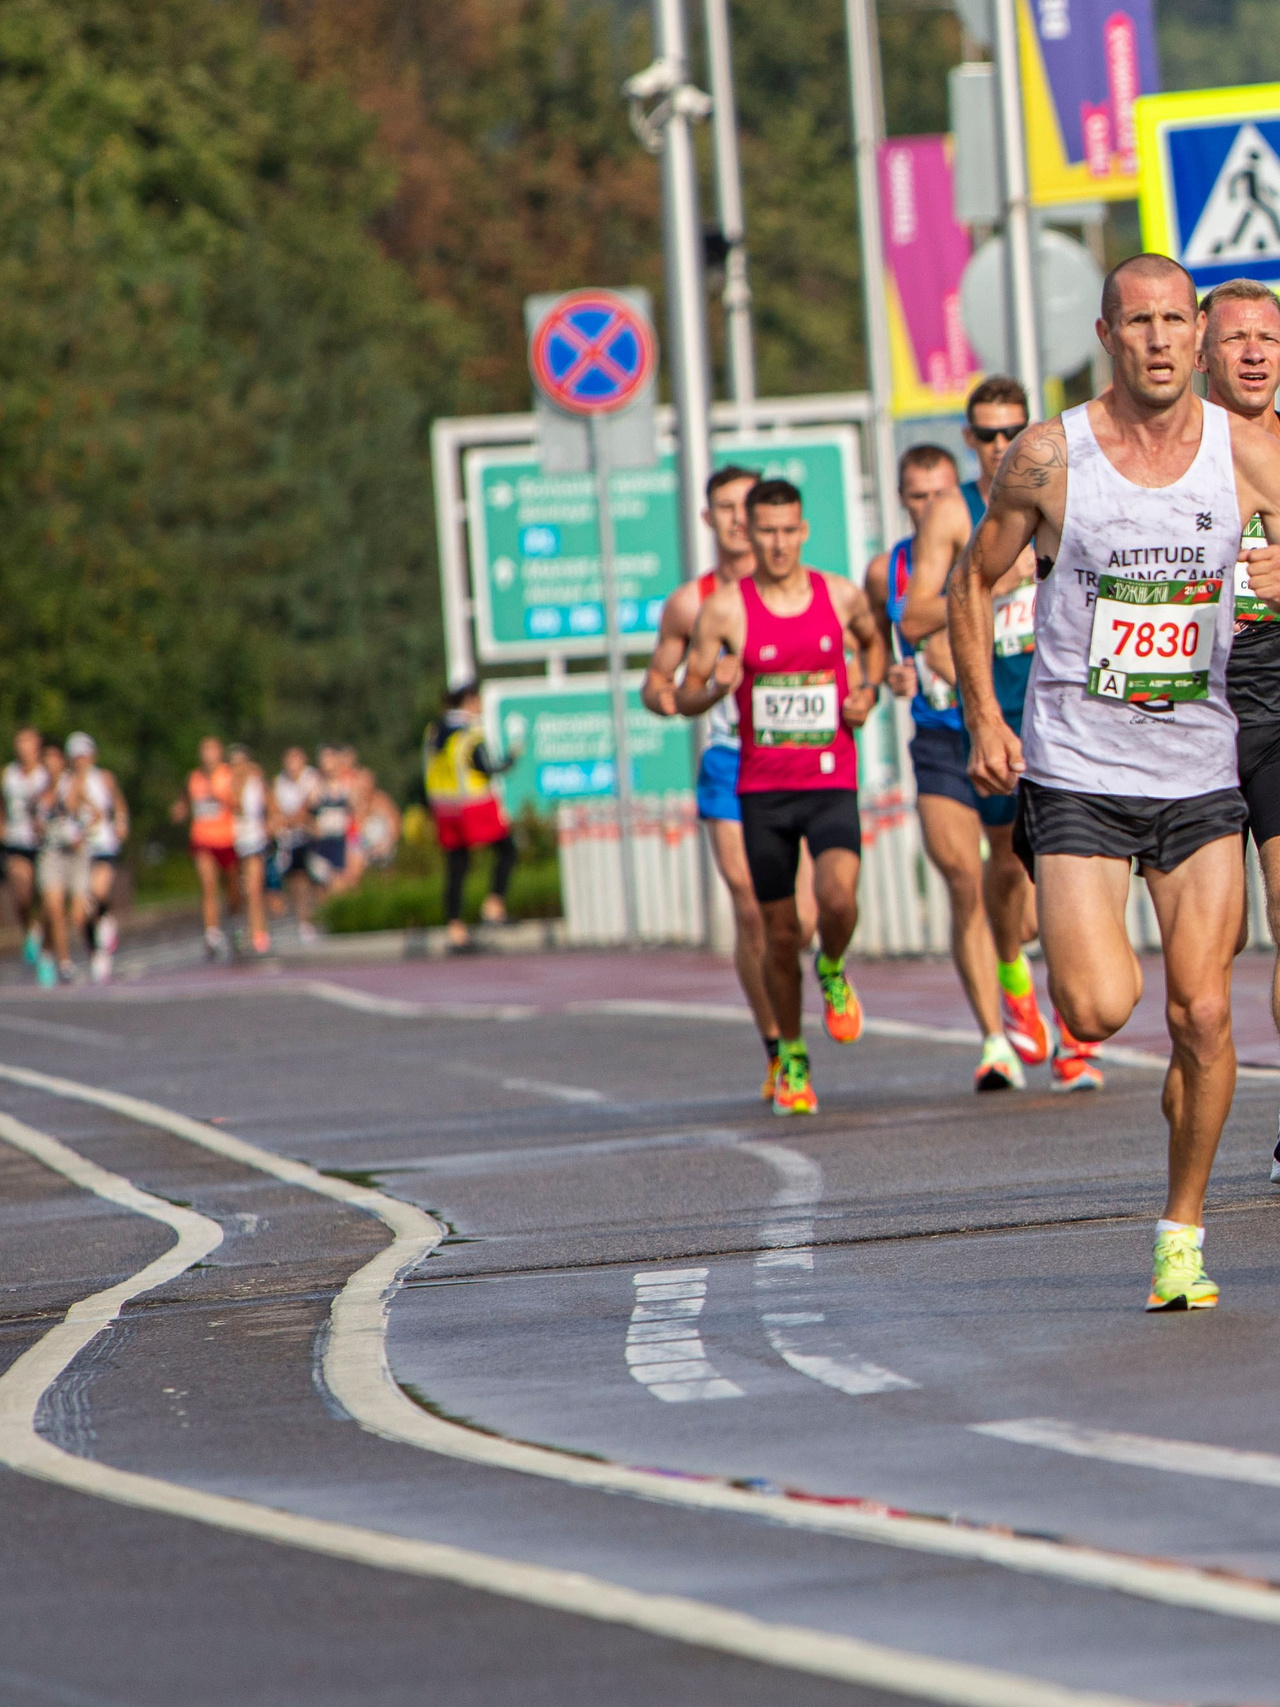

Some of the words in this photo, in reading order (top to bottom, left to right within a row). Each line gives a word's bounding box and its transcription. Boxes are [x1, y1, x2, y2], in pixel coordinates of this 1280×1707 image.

[1108, 546, 1205, 568] ALTITUDE
[1112, 619, 1199, 657] 7830
[1103, 675, 1118, 694] A
[765, 694, 825, 716] 5730
